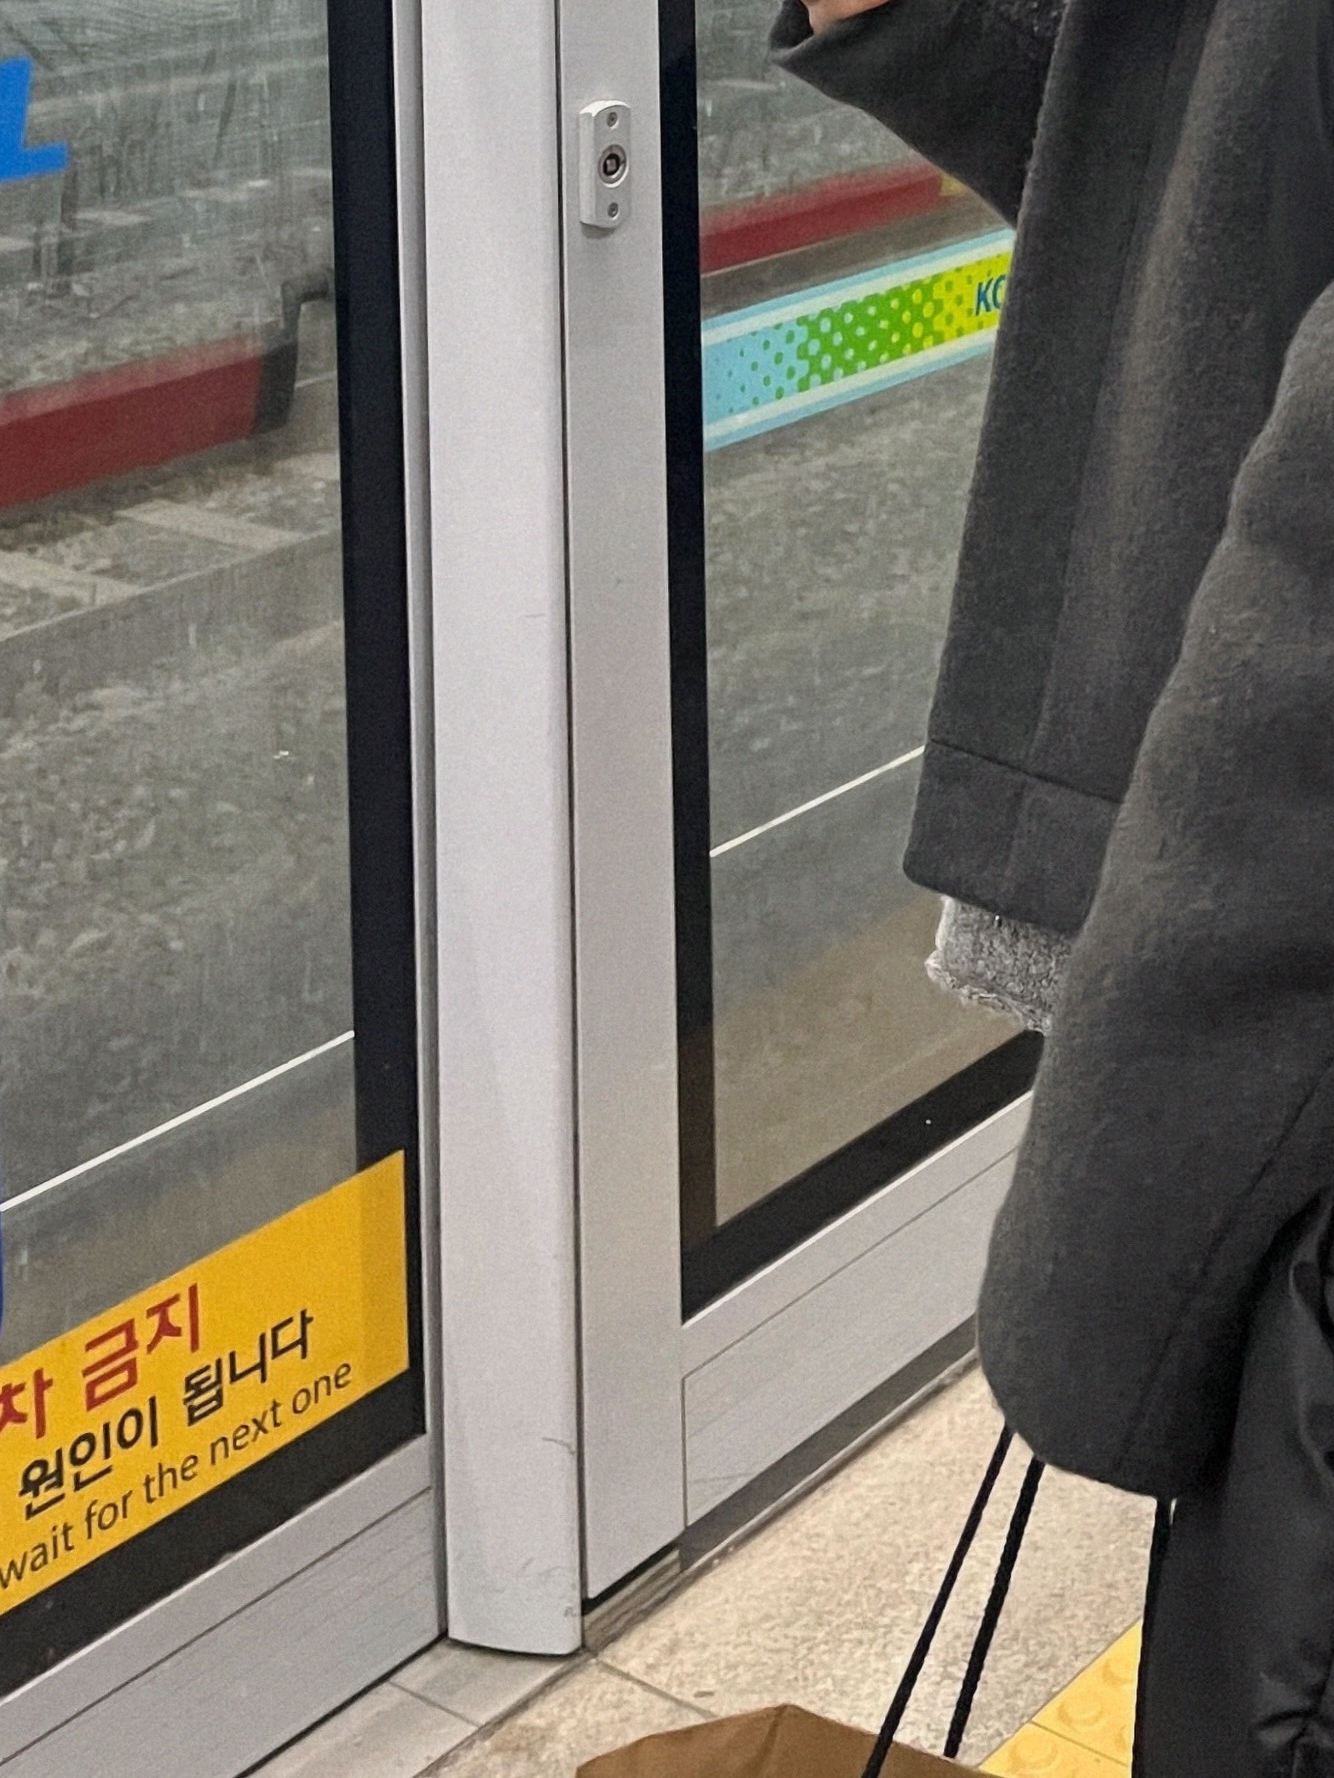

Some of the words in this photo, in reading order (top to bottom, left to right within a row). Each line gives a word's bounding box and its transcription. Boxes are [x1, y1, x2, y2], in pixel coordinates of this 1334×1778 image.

[18, 1395, 159, 1521] 원인이
[182, 1308, 314, 1427] 됩니다
[81, 1282, 201, 1413] 금지
[0, 1522, 76, 1590] wait
[85, 1489, 134, 1541] for
[142, 1453, 199, 1506] the
[208, 1399, 283, 1468] next
[291, 1361, 353, 1416] one
